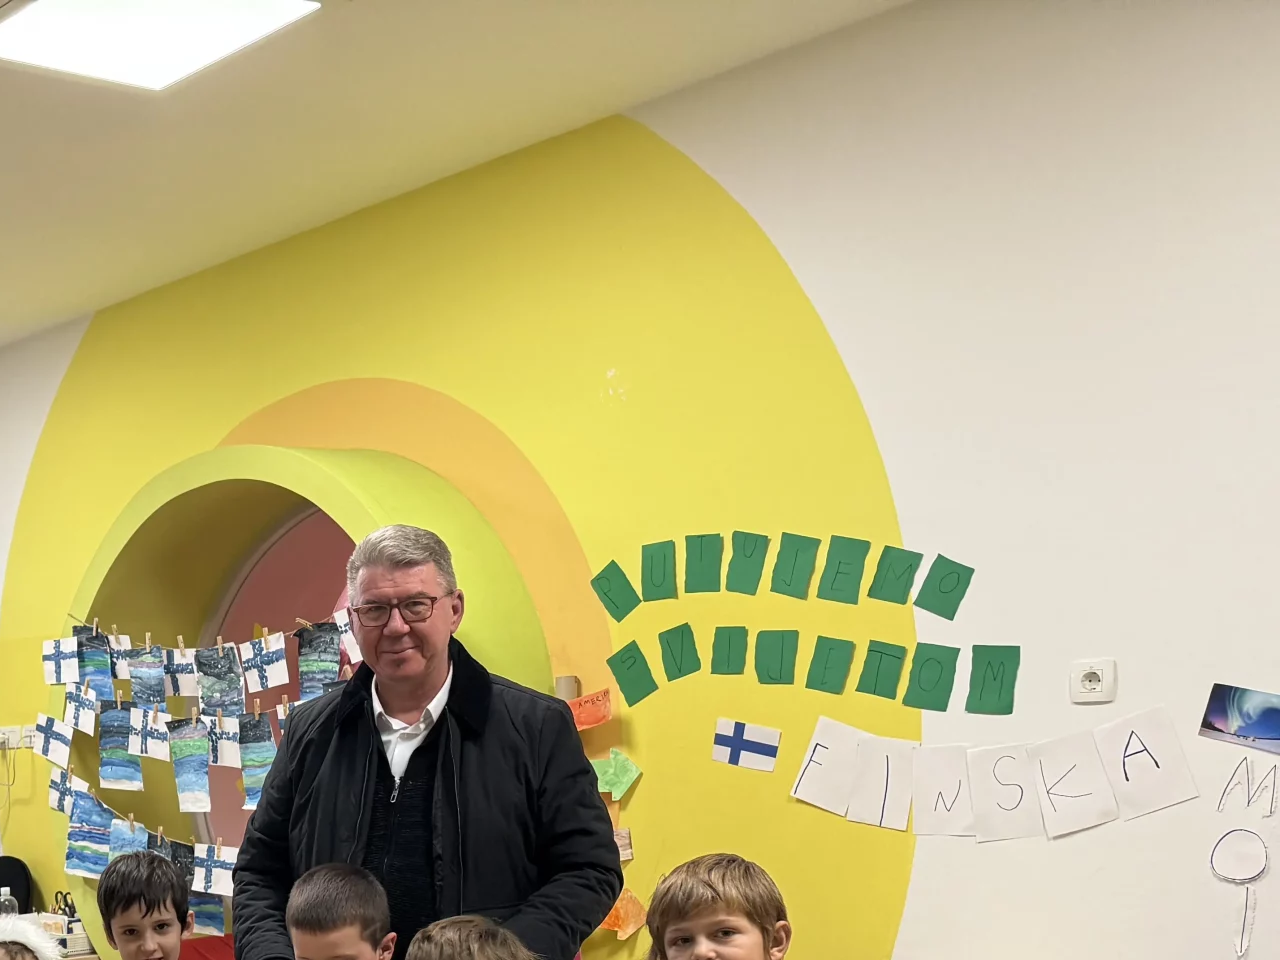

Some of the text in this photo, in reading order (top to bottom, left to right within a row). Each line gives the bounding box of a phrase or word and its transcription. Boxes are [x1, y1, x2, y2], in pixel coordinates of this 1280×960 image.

[596, 534, 960, 609] PUTUJEMO
[621, 629, 1005, 704] SVIJETOM
[793, 730, 1161, 827] FINSKA
